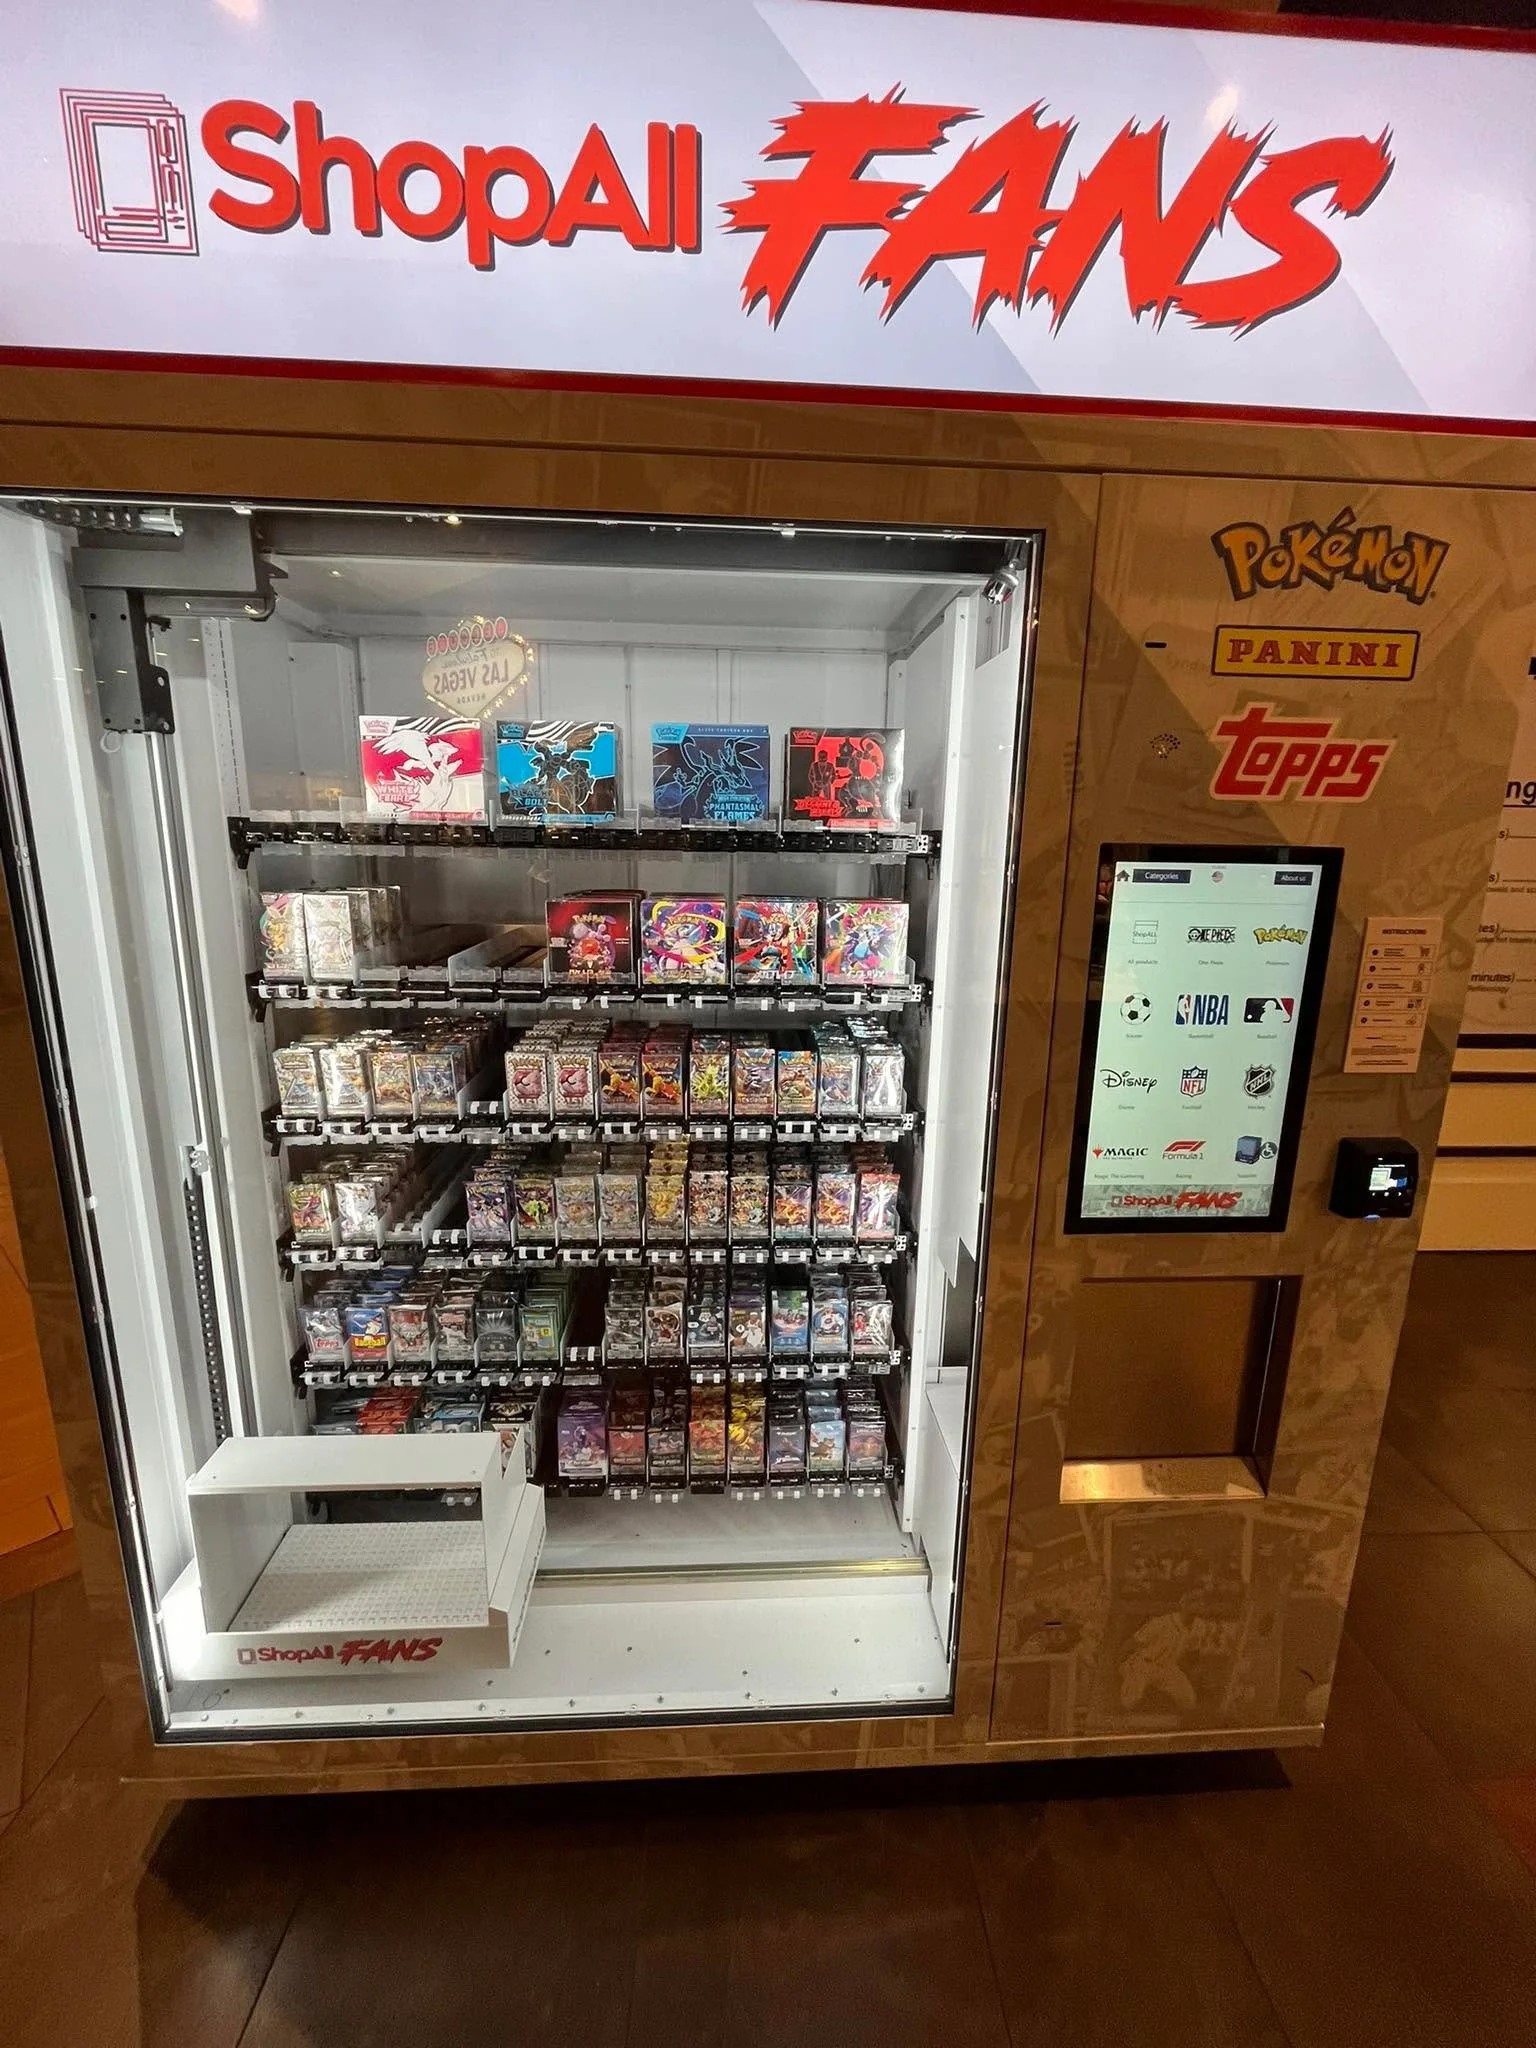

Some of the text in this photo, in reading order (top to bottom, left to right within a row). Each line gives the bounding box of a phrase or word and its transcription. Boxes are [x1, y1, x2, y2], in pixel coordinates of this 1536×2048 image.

[201, 81, 1395, 340] ShopAll FANS
[1227, 639, 1402, 667] PANINI
[525, 798, 548, 806] BOLT
[709, 803, 760, 811] PHANTASMAL
[714, 811, 756, 820] FLAMES
[1144, 872, 1179, 881] Categories
[1192, 994, 1229, 1025] NBA
[1100, 1069, 1158, 1093] Disney
[1183, 1079, 1204, 1094] NFL
[1250, 1074, 1270, 1091] NHL
[1104, 1147, 1149, 1156] MAGIC
[1124, 1191, 1243, 1210] ShopAll FANS
[257, 1637, 443, 1666] ShopAll FANS
